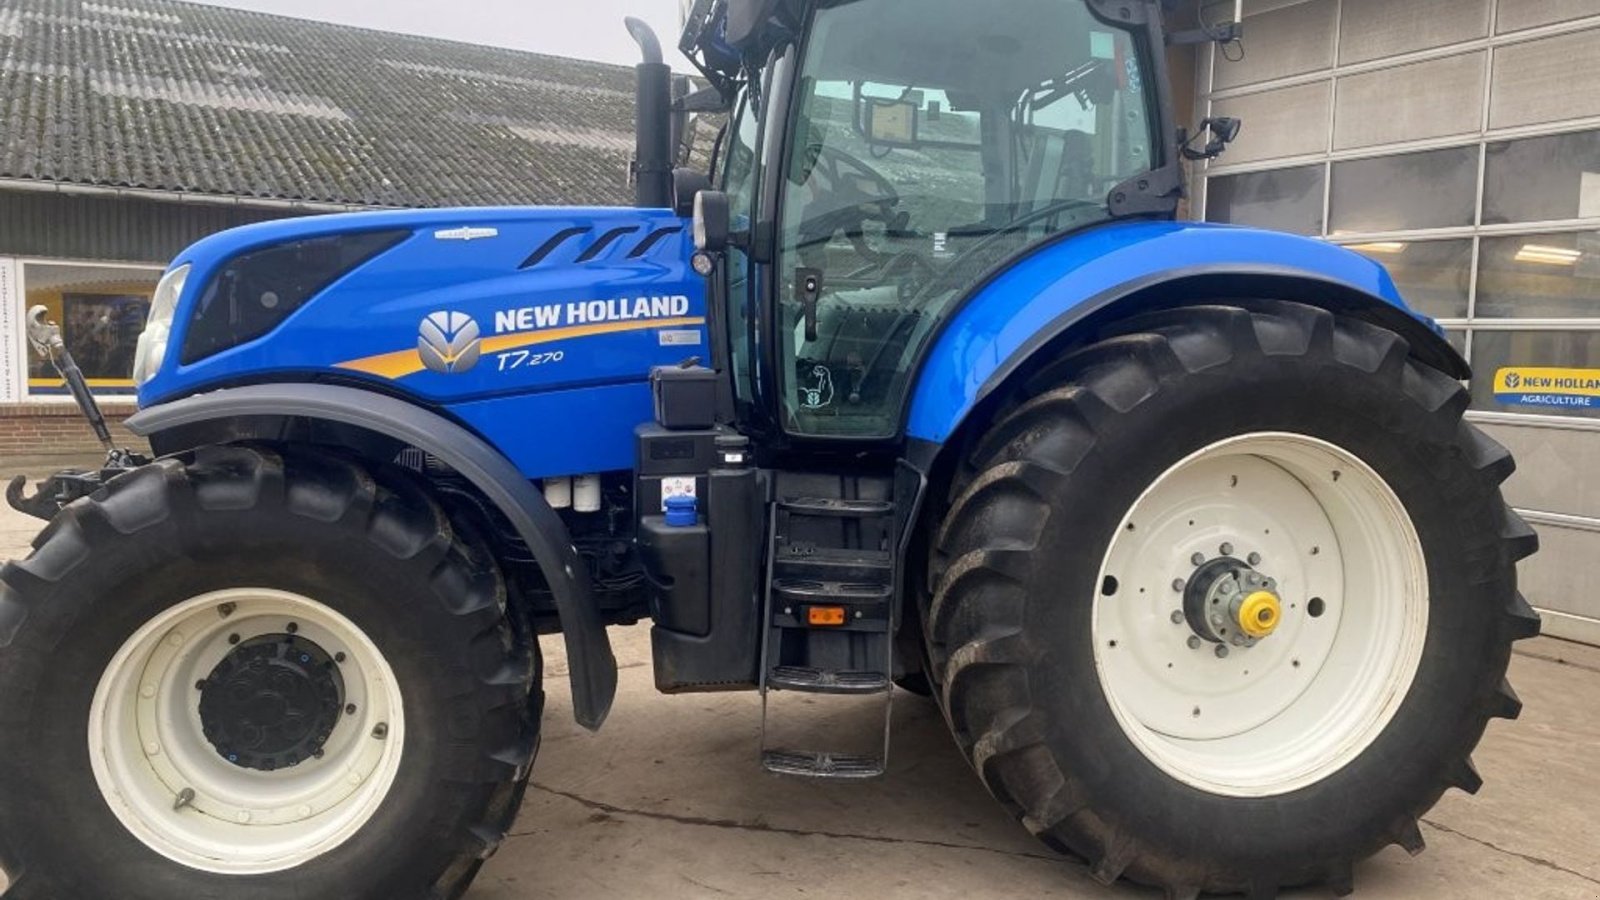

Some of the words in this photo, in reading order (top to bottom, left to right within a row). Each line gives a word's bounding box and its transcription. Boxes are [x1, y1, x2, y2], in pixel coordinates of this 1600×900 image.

[495, 304, 561, 333] NEW
[566, 295, 689, 324] HOLLAND
[496, 349, 564, 371] T7.270
[1523, 377, 1552, 387] NEW
[1520, 394, 1591, 406] AGRICULTURE
